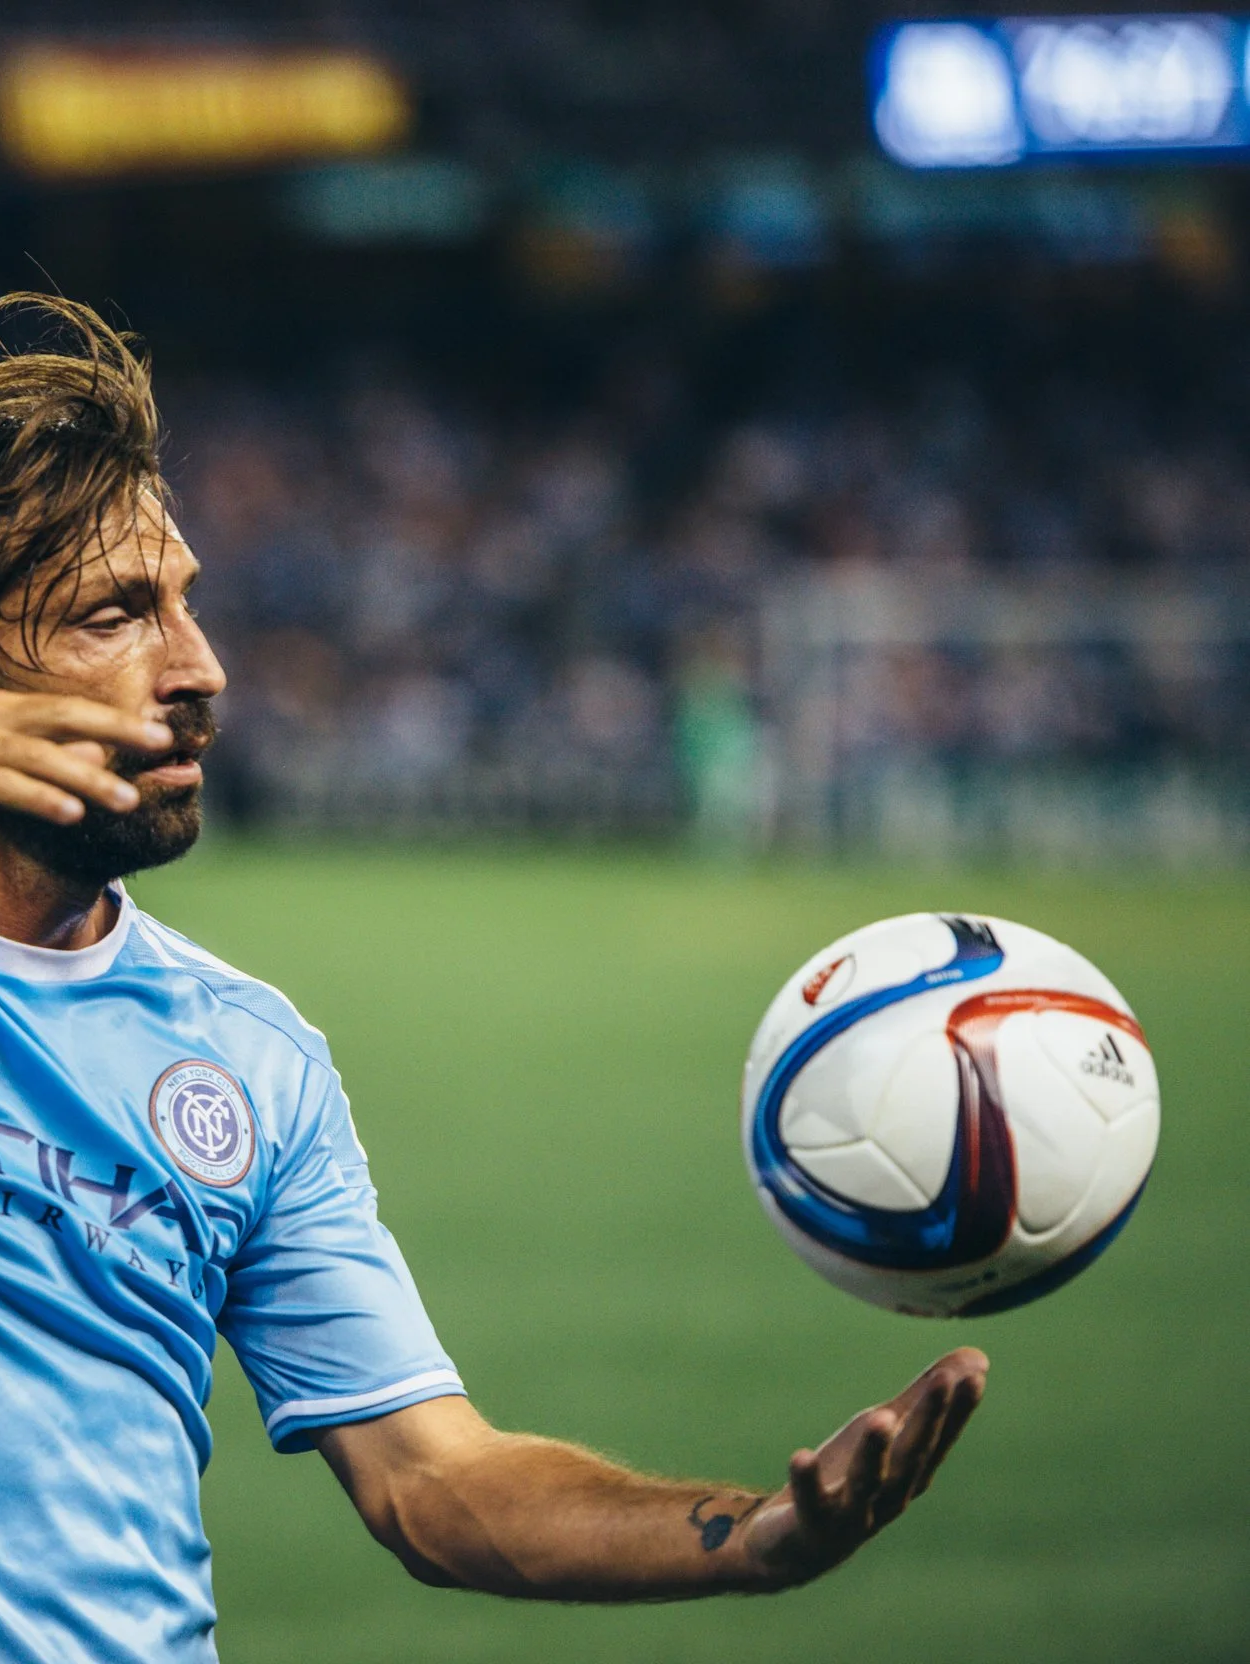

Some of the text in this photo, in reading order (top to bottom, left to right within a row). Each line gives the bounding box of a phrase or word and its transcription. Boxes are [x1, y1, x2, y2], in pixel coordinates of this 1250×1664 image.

[167, 1068, 237, 1096] NEW YORK CITY
